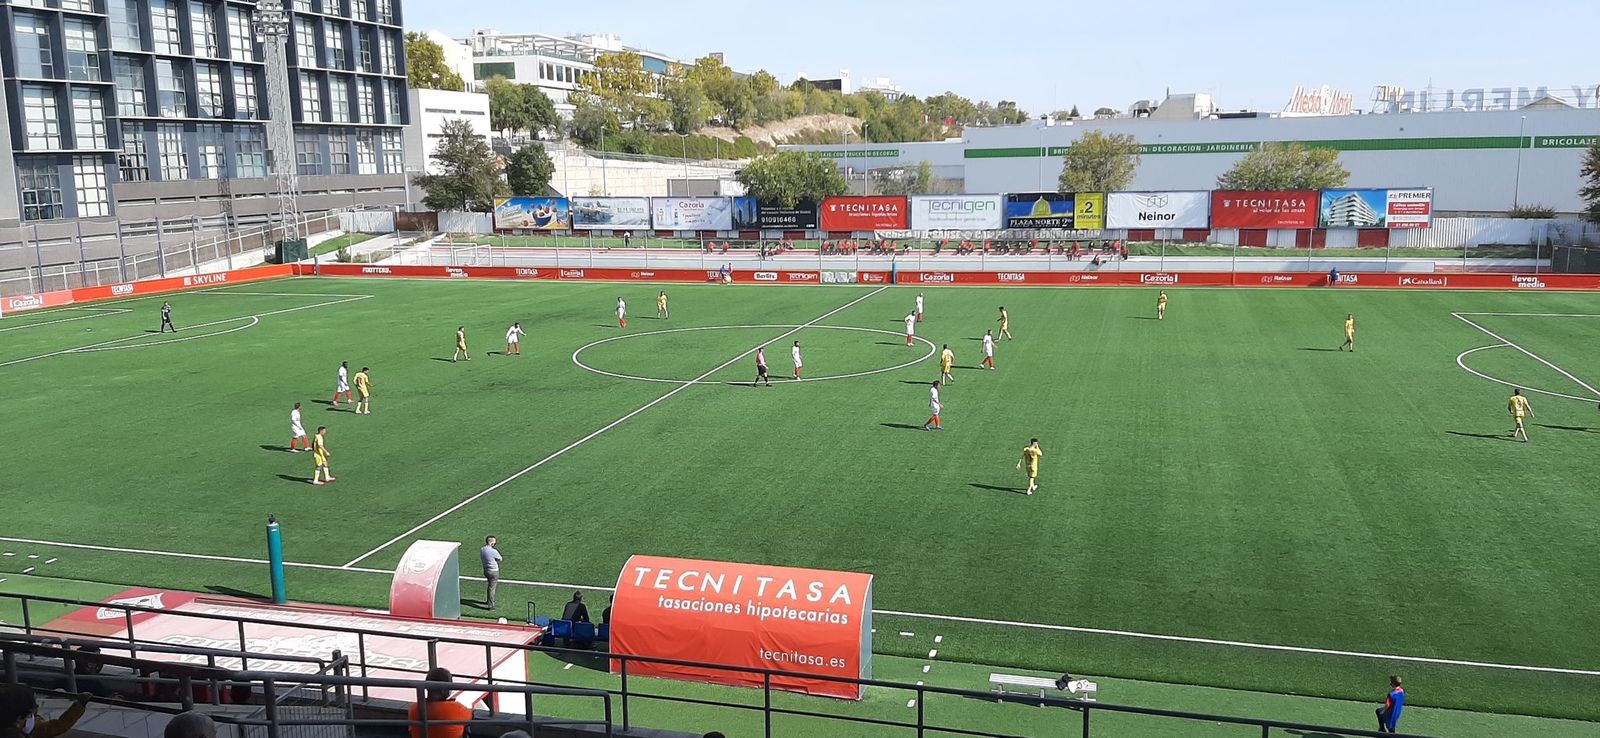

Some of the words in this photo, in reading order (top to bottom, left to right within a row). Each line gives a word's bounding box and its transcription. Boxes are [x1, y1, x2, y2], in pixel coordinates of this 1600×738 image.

[1542, 138, 1597, 146] BRICOLAJE
[1206, 143, 1254, 151] JARDINERIA
[679, 201, 705, 209] Cazorla
[1084, 201, 1093, 213] 2
[1236, 199, 1305, 207] TECNITASA
[840, 204, 898, 212] TECNITASA
[1138, 212, 1175, 221] Neinor
[192, 273, 227, 285] SKYLINE
[924, 273, 950, 281] Cazorla
[997, 273, 1025, 281] TECNITASA
[1144, 273, 1174, 282] Cazorla
[1412, 276, 1442, 285] CaixaBank
[634, 567, 851, 604] TECNITASA
[658, 595, 741, 615] tasaciones
[747, 600, 848, 625] hipotecarias
[759, 648, 845, 668] tecnitasa.es
